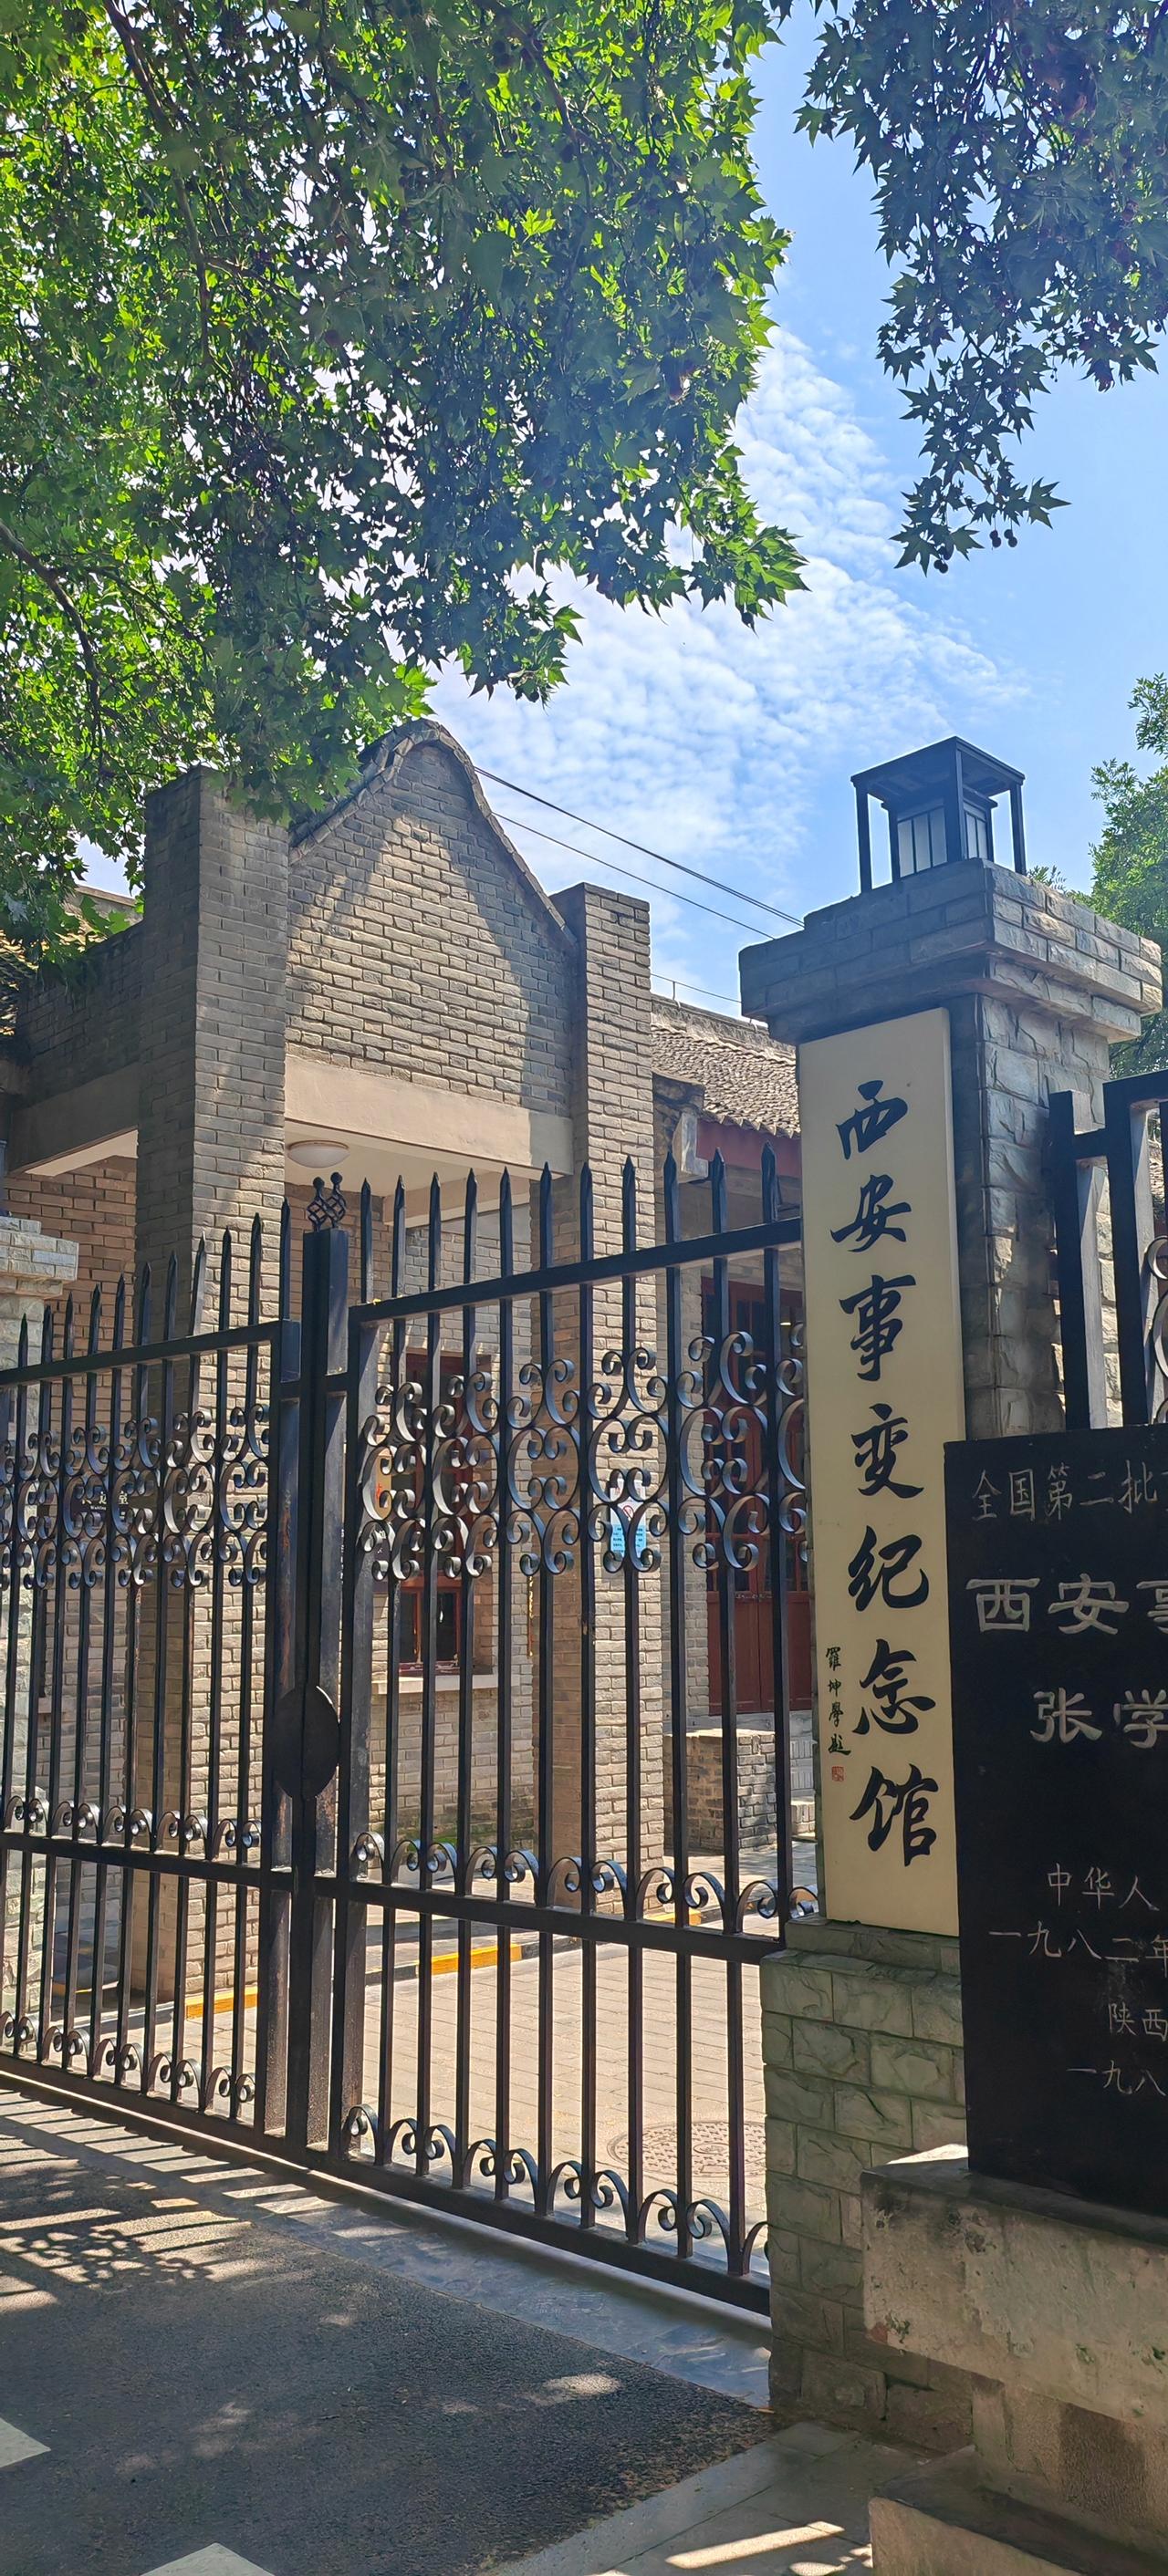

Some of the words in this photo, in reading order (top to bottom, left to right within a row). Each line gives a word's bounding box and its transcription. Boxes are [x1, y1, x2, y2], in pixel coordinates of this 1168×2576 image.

[830, 1080, 939, 1867] 西安事变纪念馆
[972, 1459, 1168, 1521] 全国第二批
[1029, 1687, 1168, 1749] 张学
[1047, 1863, 1160, 1911] 中华人
[988, 1920, 1168, 1978] 一九八二年
[1108, 2001, 1168, 2041] 陕西
[1066, 2060, 1166, 2096] 一九八
